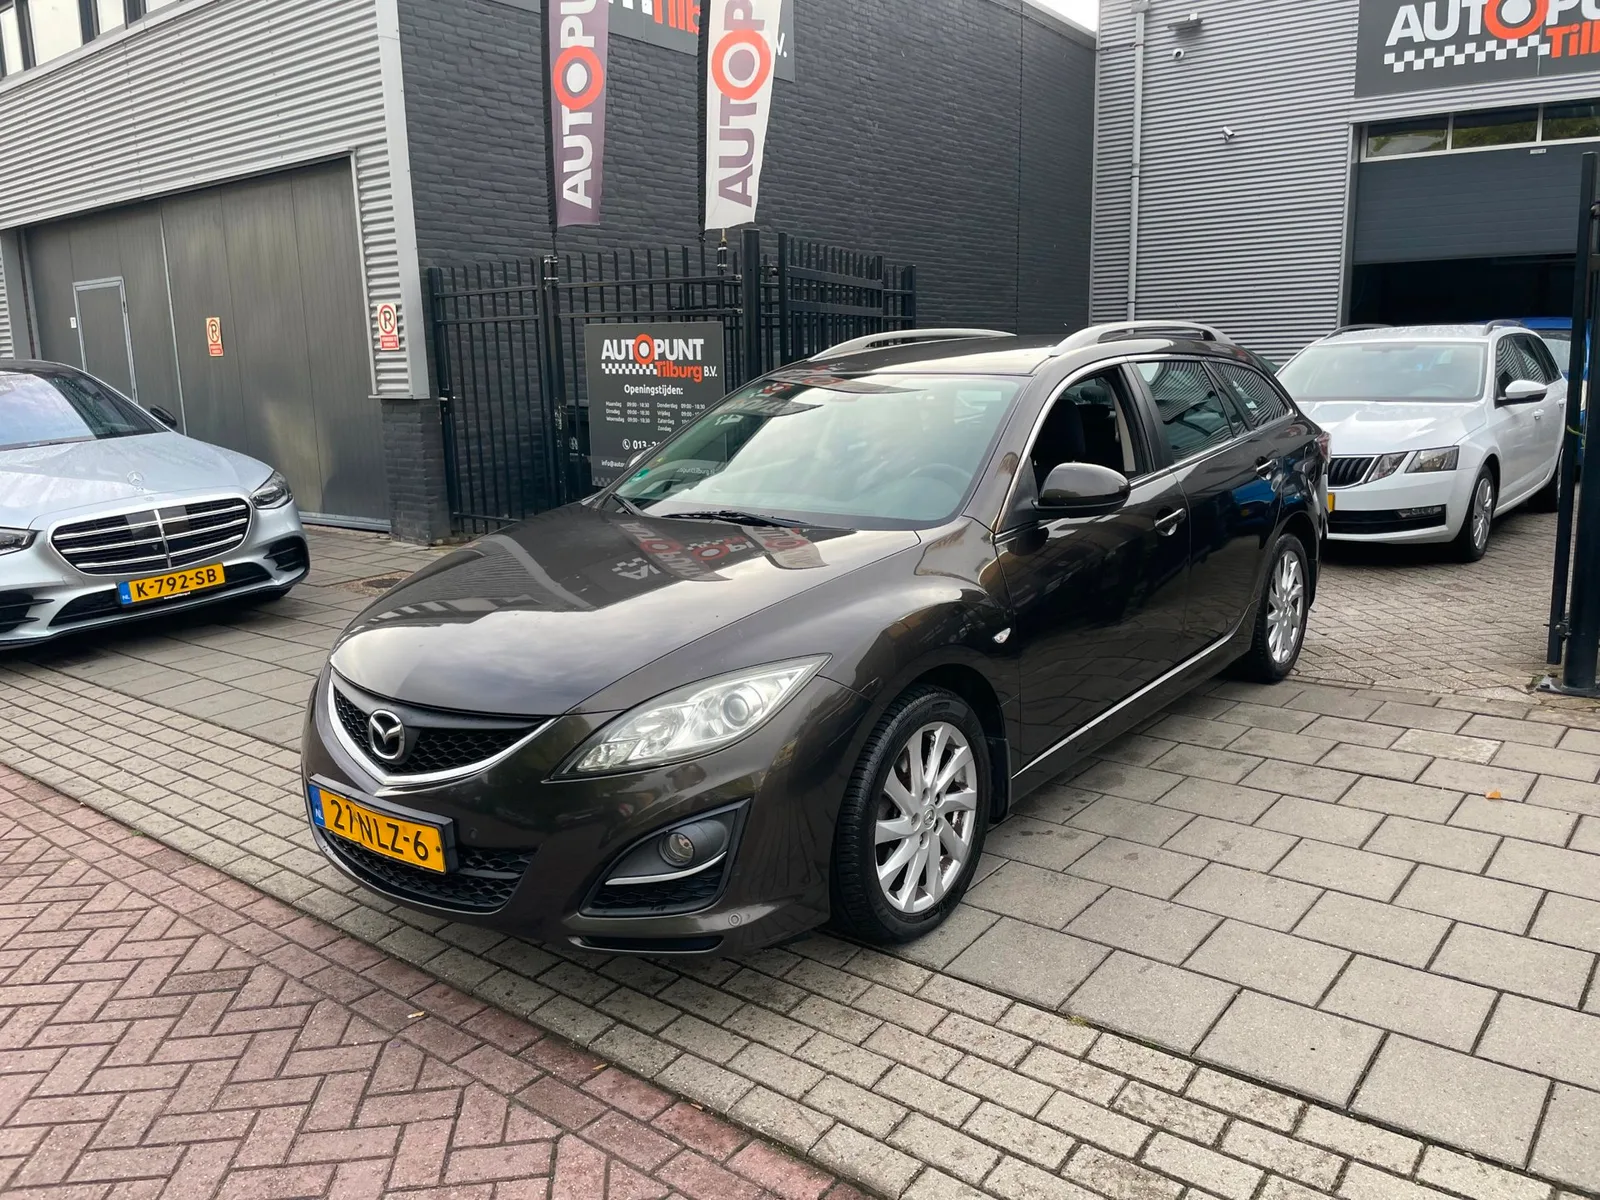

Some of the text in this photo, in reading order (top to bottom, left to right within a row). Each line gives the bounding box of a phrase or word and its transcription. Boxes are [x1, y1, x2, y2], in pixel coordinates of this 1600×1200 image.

[601, 333, 704, 365] AUTOPUNT
[655, 360, 718, 383] Tilburg B.V.
[624, 384, 684, 396] Openingstijden:
[136, 568, 217, 597] K-792-SB
[315, 808, 324, 820] NL
